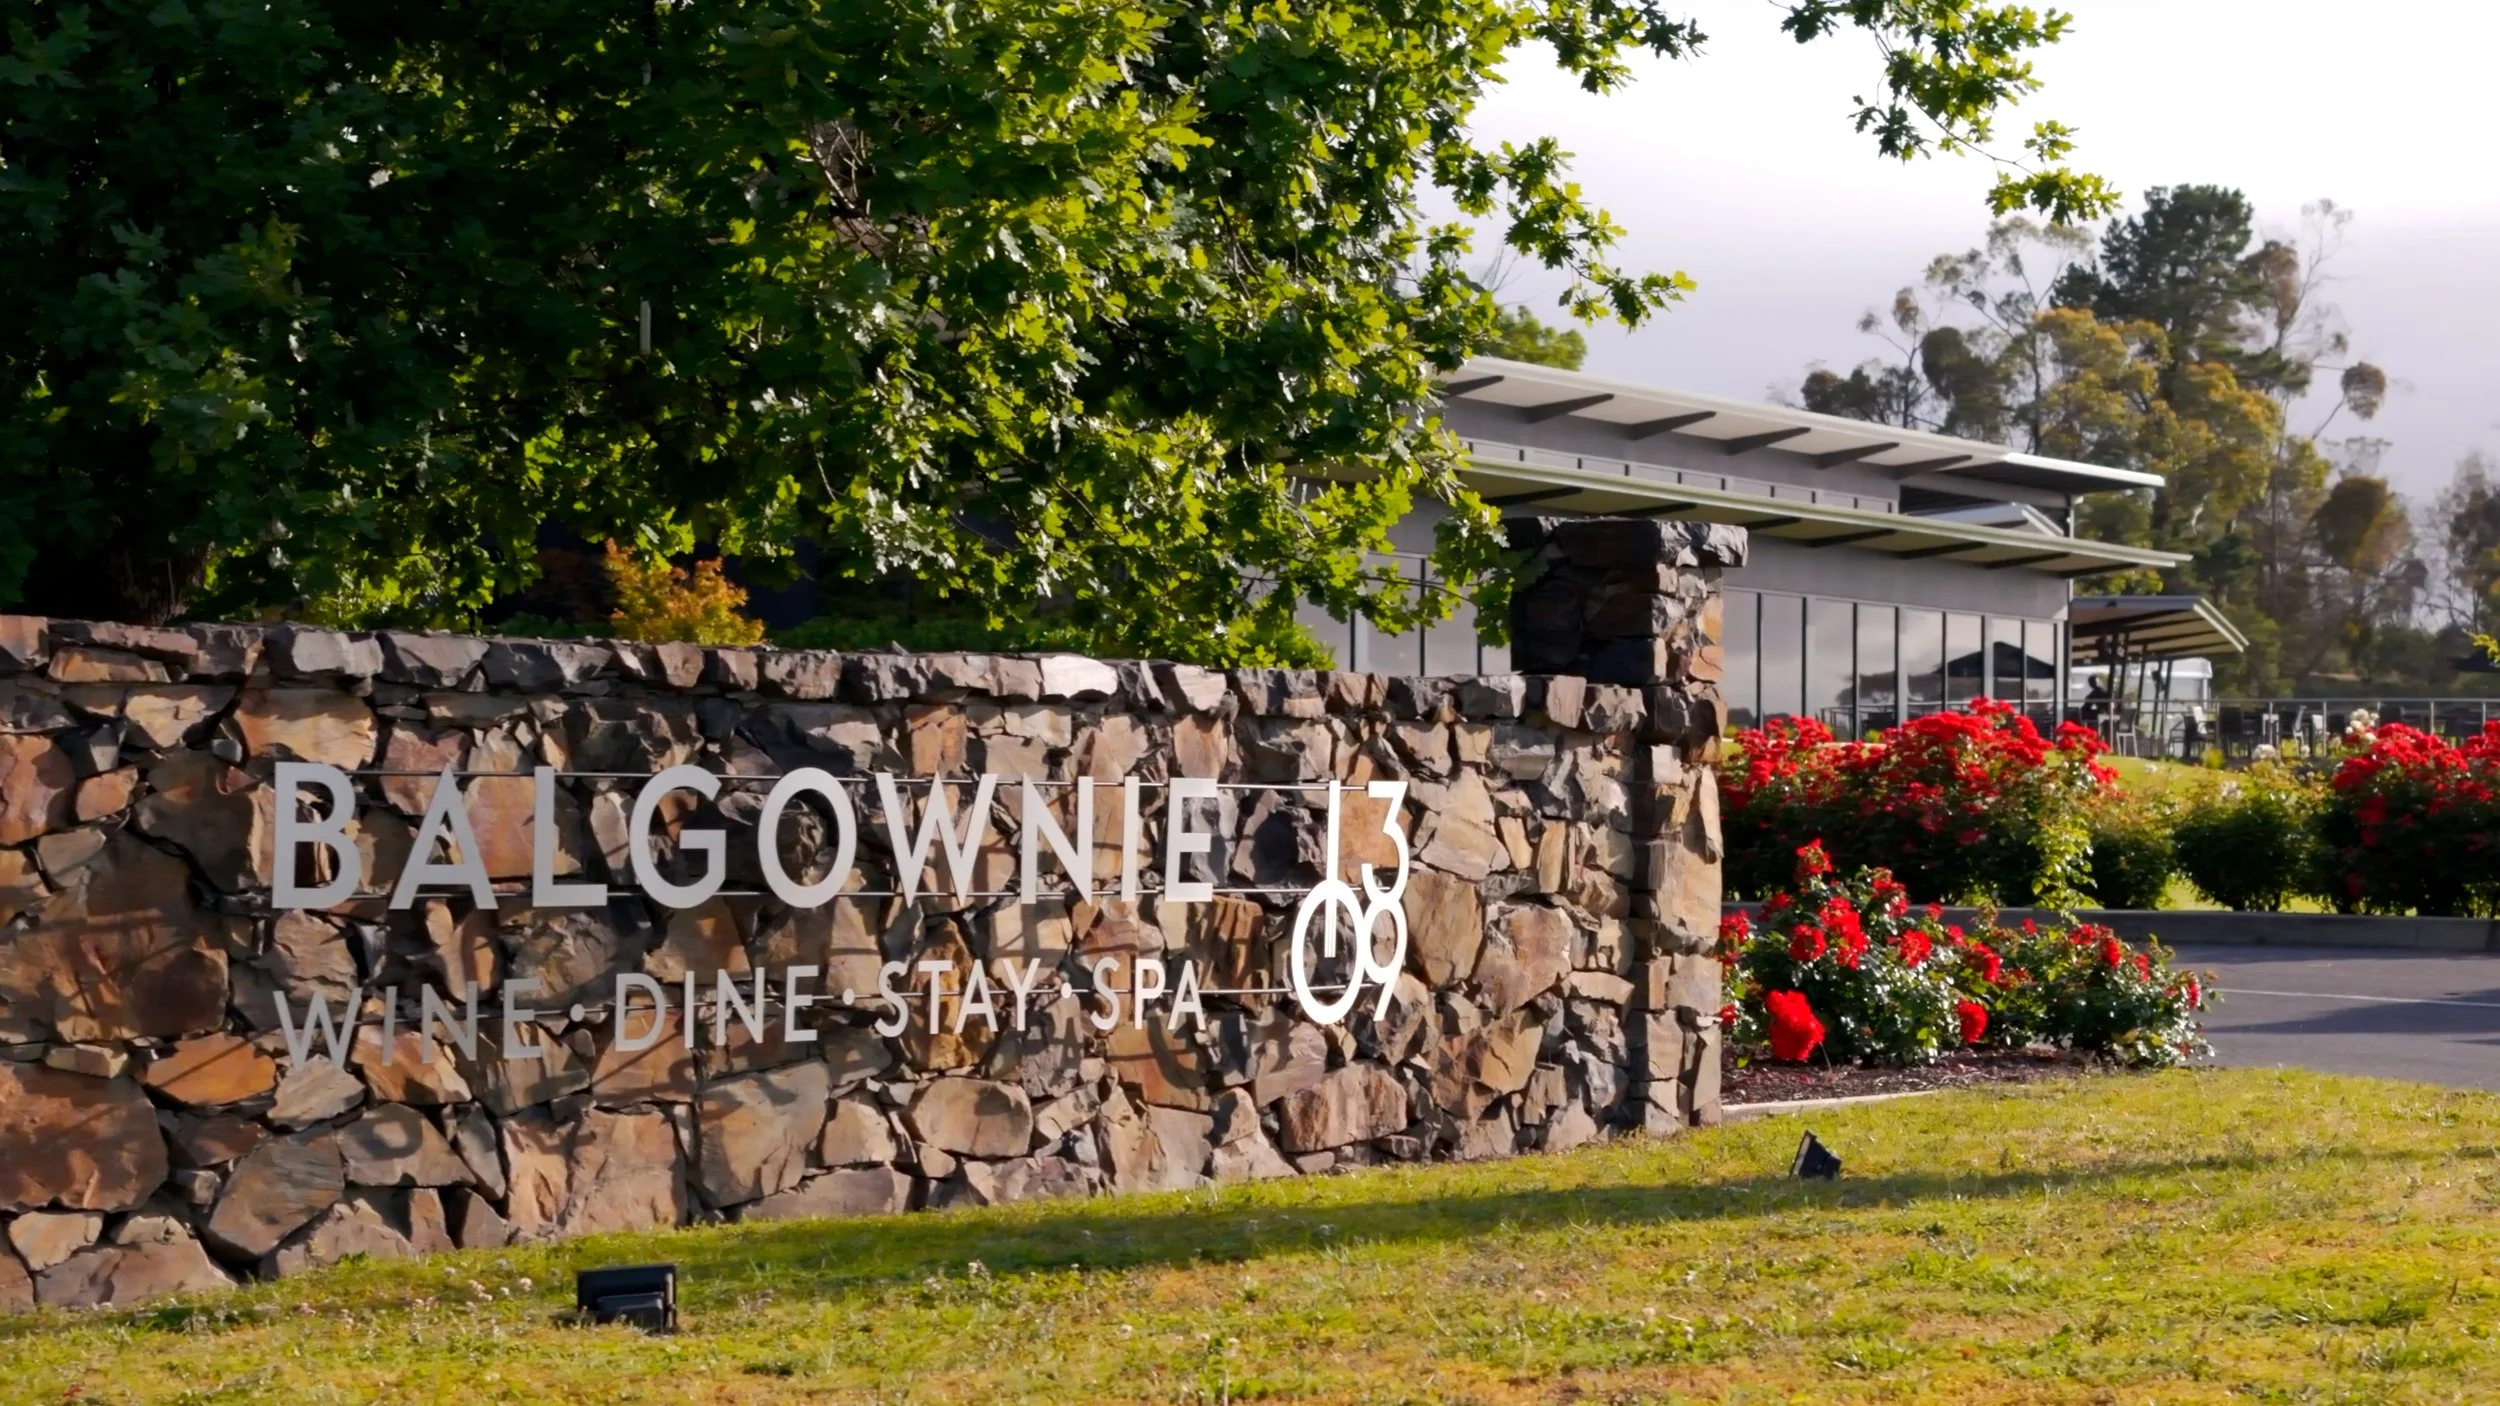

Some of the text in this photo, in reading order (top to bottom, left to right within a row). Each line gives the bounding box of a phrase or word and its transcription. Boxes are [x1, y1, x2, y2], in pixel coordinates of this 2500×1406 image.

[272, 761, 1218, 910] BALGOWNIE
[273, 957, 1207, 1070] WINE DINE STAY SPA
